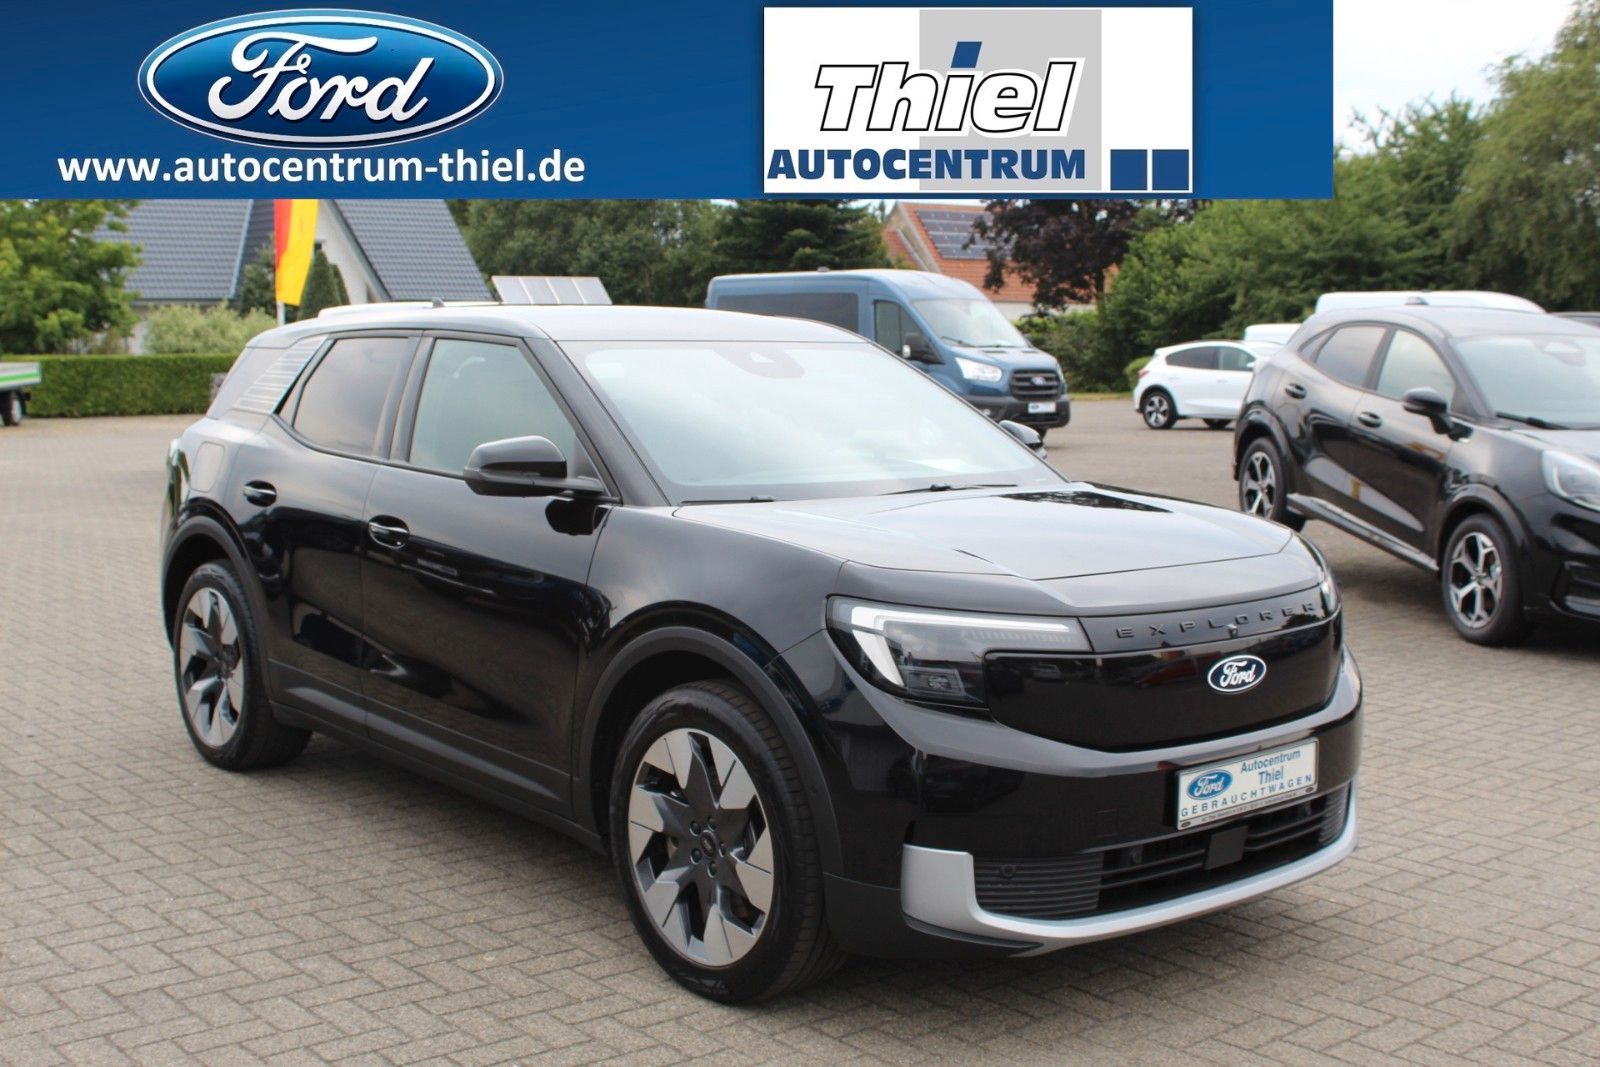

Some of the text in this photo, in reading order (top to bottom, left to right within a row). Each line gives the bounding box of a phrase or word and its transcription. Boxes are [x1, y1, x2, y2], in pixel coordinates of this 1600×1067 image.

[1116, 602, 1317, 639] EXPLORER
[1219, 660, 1257, 688] Ford
[1240, 750, 1301, 773] Autocentrum
[1193, 774, 1225, 797] Ford
[1258, 766, 1284, 785] Thiel
[1181, 774, 1312, 817] GEBRAUCHTWAGEN
